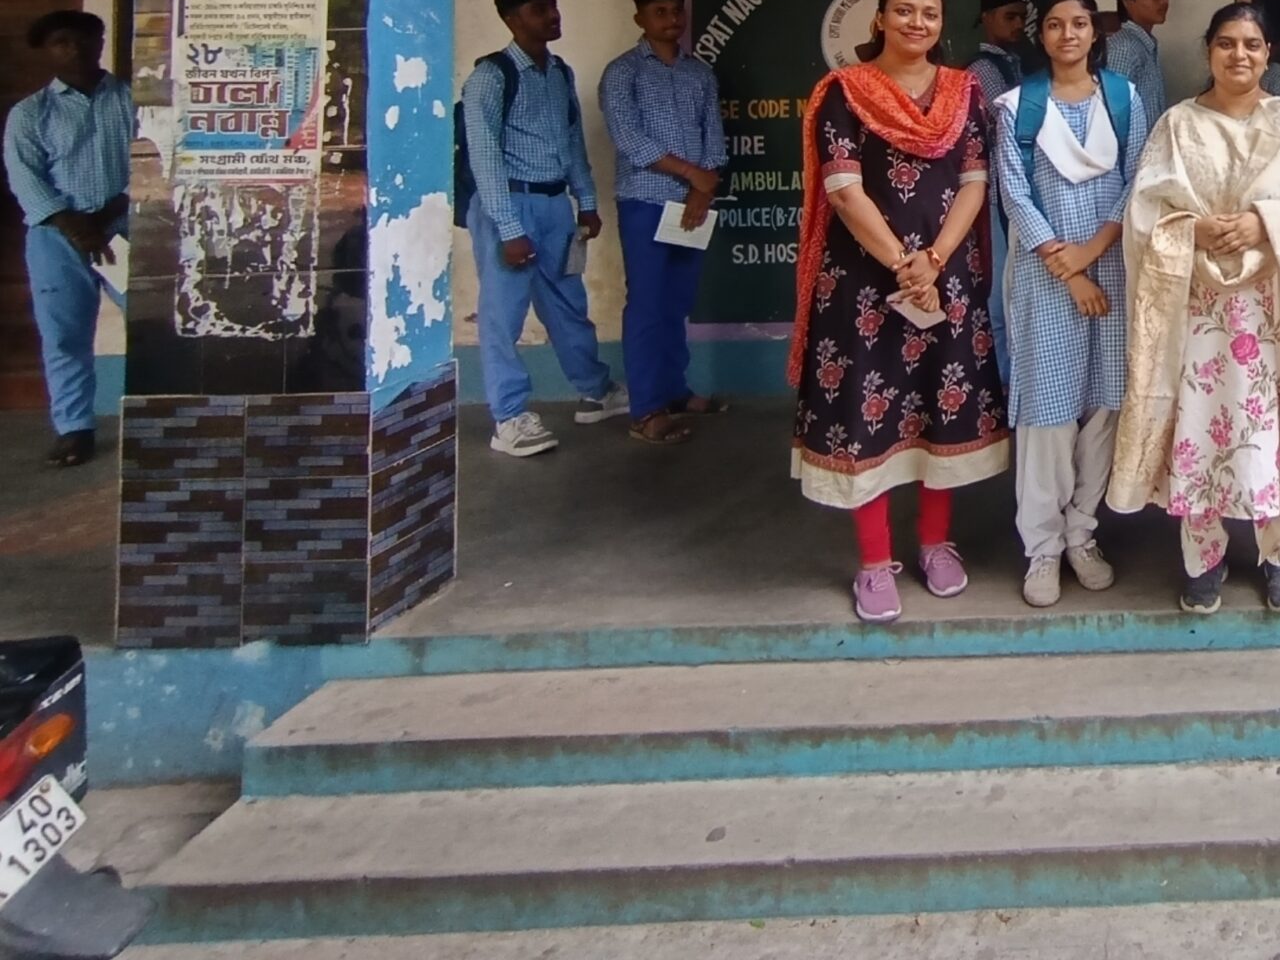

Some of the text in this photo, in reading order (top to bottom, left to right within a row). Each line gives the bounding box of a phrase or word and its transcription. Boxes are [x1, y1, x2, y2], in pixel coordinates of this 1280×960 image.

[693, 14, 734, 66] ISPAT
[186, 43, 222, 65] ২৮
[185, 66, 216, 79] জীবন
[220, 69, 246, 79] যখন
[748, 99, 790, 119] CODE
[186, 109, 291, 139] নবান্ন
[200, 152, 246, 165] সংগ্রামী
